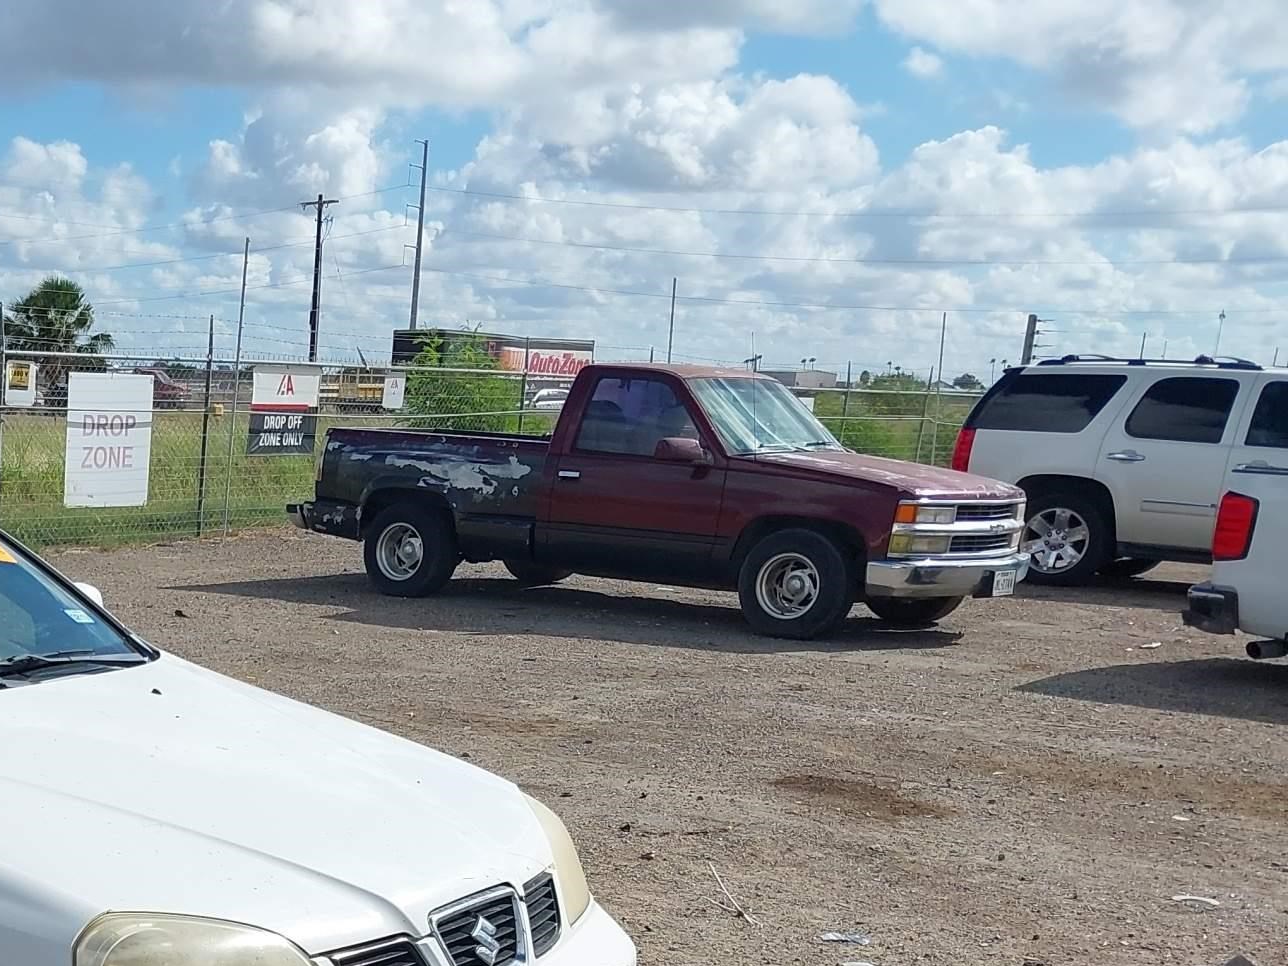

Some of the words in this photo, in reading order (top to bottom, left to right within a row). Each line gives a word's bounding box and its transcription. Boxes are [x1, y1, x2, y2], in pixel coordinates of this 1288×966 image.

[82, 414, 137, 436] DROP
[263, 415, 287, 430] DROP
[287, 415, 304, 430] OFF
[259, 432, 282, 447] ZONE
[282, 432, 304, 447] ONLY
[80, 446, 135, 469] ZONE
